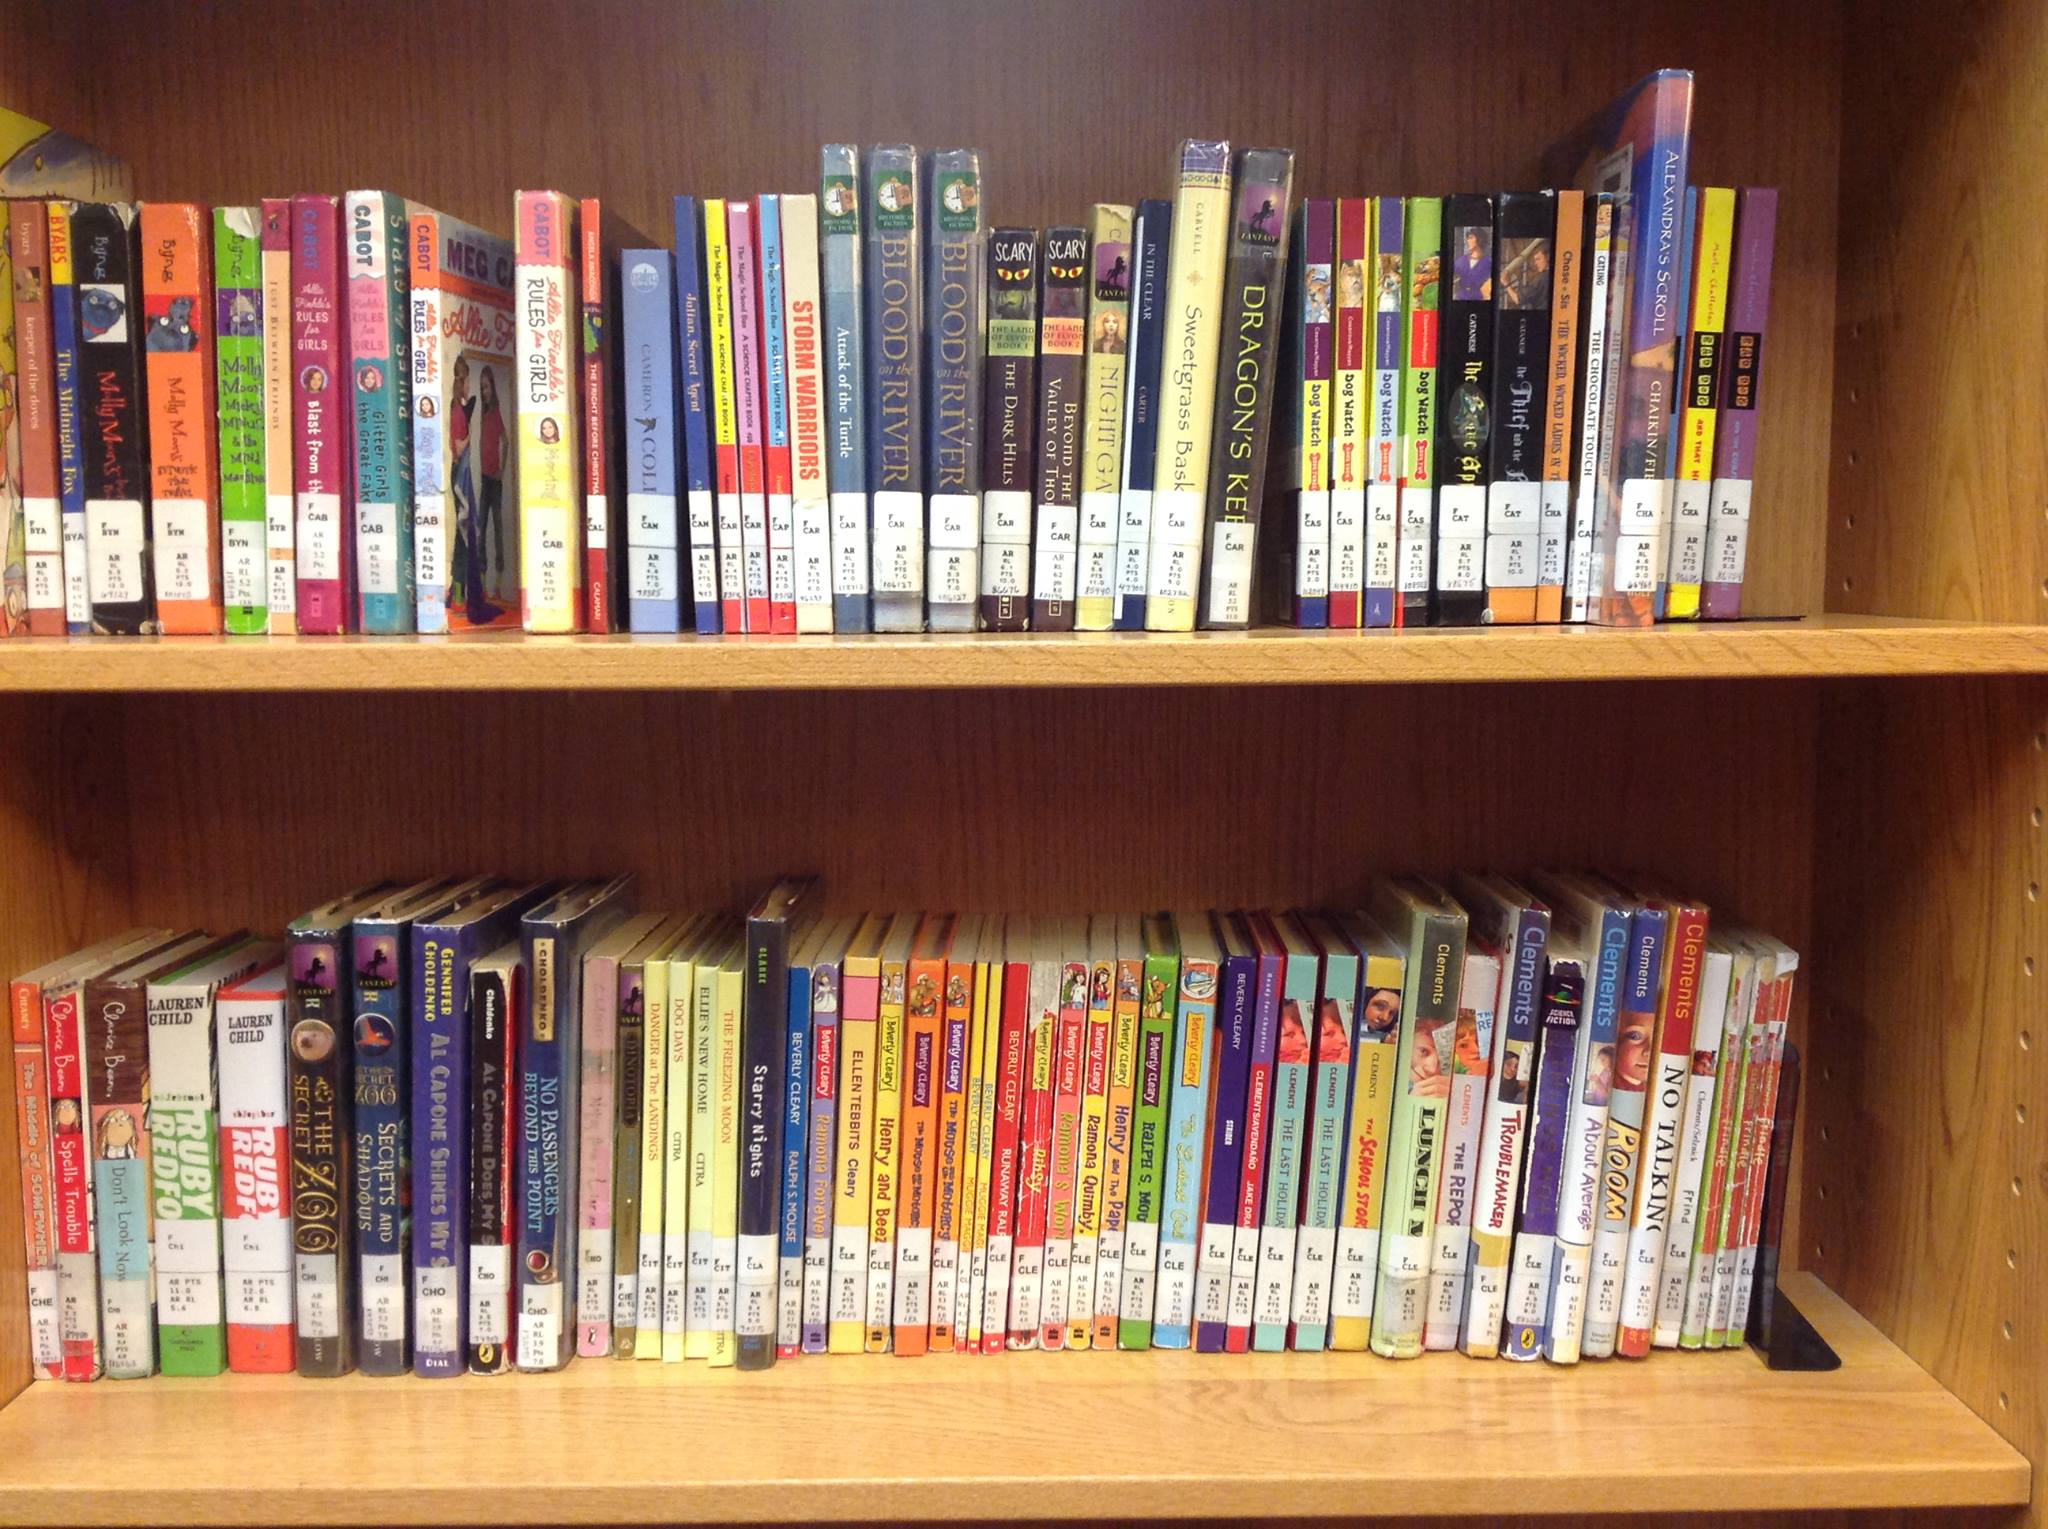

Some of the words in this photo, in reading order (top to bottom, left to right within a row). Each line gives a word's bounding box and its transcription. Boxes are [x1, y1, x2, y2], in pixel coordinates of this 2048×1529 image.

[1658, 150, 1680, 265] ALEXANDRA'S
[50, 216, 67, 264] BYARS
[354, 205, 372, 266] CABOT
[416, 224, 430, 272] CABOT
[534, 203, 550, 257] CABOT
[1048, 240, 1086, 259] SCARY
[1148, 244, 1156, 255] IN
[1240, 232, 1278, 243] FANTASY
[995, 242, 1034, 261] SCARY
[1146, 259, 1155, 278] THE
[1561, 251, 1573, 284] Chase
[1595, 255, 1606, 286] CATLING
[527, 279, 545, 327] RULES
[882, 236, 909, 361] BLOOD
[940, 242, 967, 364] BLOOD
[1143, 283, 1155, 320] CLEAR
[1560, 294, 1570, 309] Sis
[1653, 270, 1671, 337] SCROLL
[792, 301, 815, 370] STORM
[837, 327, 850, 370] Attack
[1468, 313, 1477, 353] CATANESE
[1558, 320, 1570, 338] THE
[1591, 330, 1602, 355] THE
[58, 349, 70, 381] The
[530, 354, 547, 403] GIRLS
[640, 344, 653, 411] CAMERON
[840, 374, 848, 387] of
[1006, 362, 1015, 389] THE
[1173, 305, 1202, 430] Sweetgrass
[1230, 286, 1265, 459] DRAGON'S
[1342, 373, 1355, 396] Dog
[1380, 373, 1392, 396] Dog
[1417, 371, 1429, 396] Dog
[840, 389, 848, 413] the
[1047, 378, 1062, 435] VALLEY
[1098, 367, 1118, 448] NIGHT
[1309, 384, 1320, 406] Dog
[1553, 384, 1566, 418] WICKED
[1586, 358, 1599, 431] CHOCOLATE
[59, 387, 76, 459] Midnight
[795, 375, 820, 480] WARRIORS
[883, 381, 909, 484] RIVER
[939, 384, 967, 487] RIVER
[1004, 395, 1018, 439] DARK
[1063, 403, 1077, 466] BEYOND
[1311, 409, 1320, 447] Watch
[1344, 400, 1354, 437] Watch
[1381, 399, 1393, 437] Watch
[1417, 398, 1429, 435] Watch
[308, 438, 323, 474] from
[840, 418, 853, 458] Turtle
[1551, 422, 1564, 454] LADIES
[1584, 435, 1595, 477] TOUCH
[63, 464, 77, 494] Fox
[1003, 443, 1017, 485] HILLS
[1174, 440, 1195, 491] Bask
[1550, 457, 1561, 466] IN
[1062, 470, 1072, 501] THE
[361, 524, 383, 533] CAB
[415, 516, 438, 525] CAB
[1304, 519, 1321, 527] CAS
[1452, 514, 1469, 522] CAT
[424, 941, 438, 1022] CHOLDENKO
[441, 948, 454, 1016] GENNIFER
[1432, 944, 1450, 1005] Clements
[1513, 927, 1546, 1026] Clements
[1596, 927, 1628, 1028] Clements
[1634, 935, 1655, 999] Clements
[1673, 924, 1705, 1020] Clements
[148, 998, 204, 1010] LAUREN
[149, 1014, 193, 1026] CHILD
[228, 1014, 273, 1030] LAUREN
[486, 989, 494, 1040] Choldenko
[674, 999, 685, 1029] DOG
[699, 987, 710, 1033] ELLIE'S
[724, 1010, 734, 1035] THE
[1546, 1017, 1576, 1025] FICTION
[1549, 1009, 1574, 1017] SCIENCE
[50, 1001, 73, 1051] Clarice
[230, 1031, 264, 1045] CHILD
[431, 1033, 450, 1059] AL
[650, 1003, 660, 1061] DANGER
[673, 1033, 683, 1063] DAYS
[698, 1036, 709, 1065] NEW
[790, 1032, 803, 1079] BEVERLY
[1007, 1031, 1020, 1077] BEVERLY
[55, 1055, 75, 1092] Bean
[483, 1062, 497, 1083] AL
[542, 1077, 558, 1104] NO
[722, 1039, 734, 1101] FREEZING
[852, 1050, 864, 1095] ELLEN
[1287, 1067, 1297, 1109] CLEMENTS
[1327, 1067, 1337, 1109] CLEMENTS
[1662, 1064, 1685, 1108] NO
[430, 1066, 450, 1141] CAPONE
[524, 1073, 538, 1142] BEYOND
[697, 1071, 708, 1114] HOME
[751, 1065, 768, 1120] Starry
[789, 1082, 802, 1125] CLEARY
[1004, 1080, 1018, 1123] CLEARY
[294, 1074, 310, 1154] SECRET
[315, 1109, 333, 1155] THE
[483, 1088, 497, 1152] CAPONE
[649, 1100, 659, 1161] LANDINGS
[721, 1106, 731, 1144] MOON
[848, 1096, 861, 1150] TEBBITS
[1109, 1105, 1130, 1155] Henry
[1282, 1118, 1294, 1141] THE
[1322, 1118, 1334, 1141] THE
[61, 1141, 78, 1184] Spells
[528, 1148, 538, 1174] THIS
[672, 1132, 681, 1162] CITRA
[750, 1125, 767, 1177] Nights
[873, 1117, 895, 1166] Henry
[1279, 1147, 1291, 1176] LAST
[1319, 1147, 1332, 1176] LAST
[1357, 1136, 1378, 1188] SCHOOL
[1413, 1106, 1437, 1210] LUNCH
[1584, 1117, 1604, 1168] About
[184, 1110, 215, 1220] RUBY
[358, 1134, 373, 1232] SHADOWS
[378, 1122, 397, 1206] SECRETS
[430, 1147, 450, 1215] SHINES
[482, 1159, 497, 1199] DOES
[542, 1109, 560, 1217] PASSENGERS
[696, 1152, 705, 1188] CITRA
[787, 1151, 800, 1191] RALPH
[845, 1158, 859, 1199] Cleary
[998, 1148, 1012, 1207] RUNAWAY
[1026, 1148, 1047, 1193] Ribsy
[1489, 1110, 1521, 1229] TROUBLEMAKER
[1604, 1118, 1640, 1220] ROOM
[111, 1167, 127, 1206] Don't
[527, 1179, 542, 1233] POINT
[1578, 1172, 1596, 1231] Average
[63, 1187, 82, 1245] Trouble
[116, 1210, 133, 1247] Look
[379, 1213, 393, 1242] AND
[482, 1202, 496, 1229] MY
[786, 1203, 798, 1243] MOUSE
[431, 1226, 449, 1258] MY
[1048, 1258, 1068, 1267] CLE
[116, 1250, 131, 1283] Now
[478, 1272, 495, 1280] CHO
[870, 1262, 890, 1270] CLE
[1164, 1262, 1184, 1270] CLE
[31, 1298, 53, 1306] CHE
[422, 1288, 446, 1296] CHO
